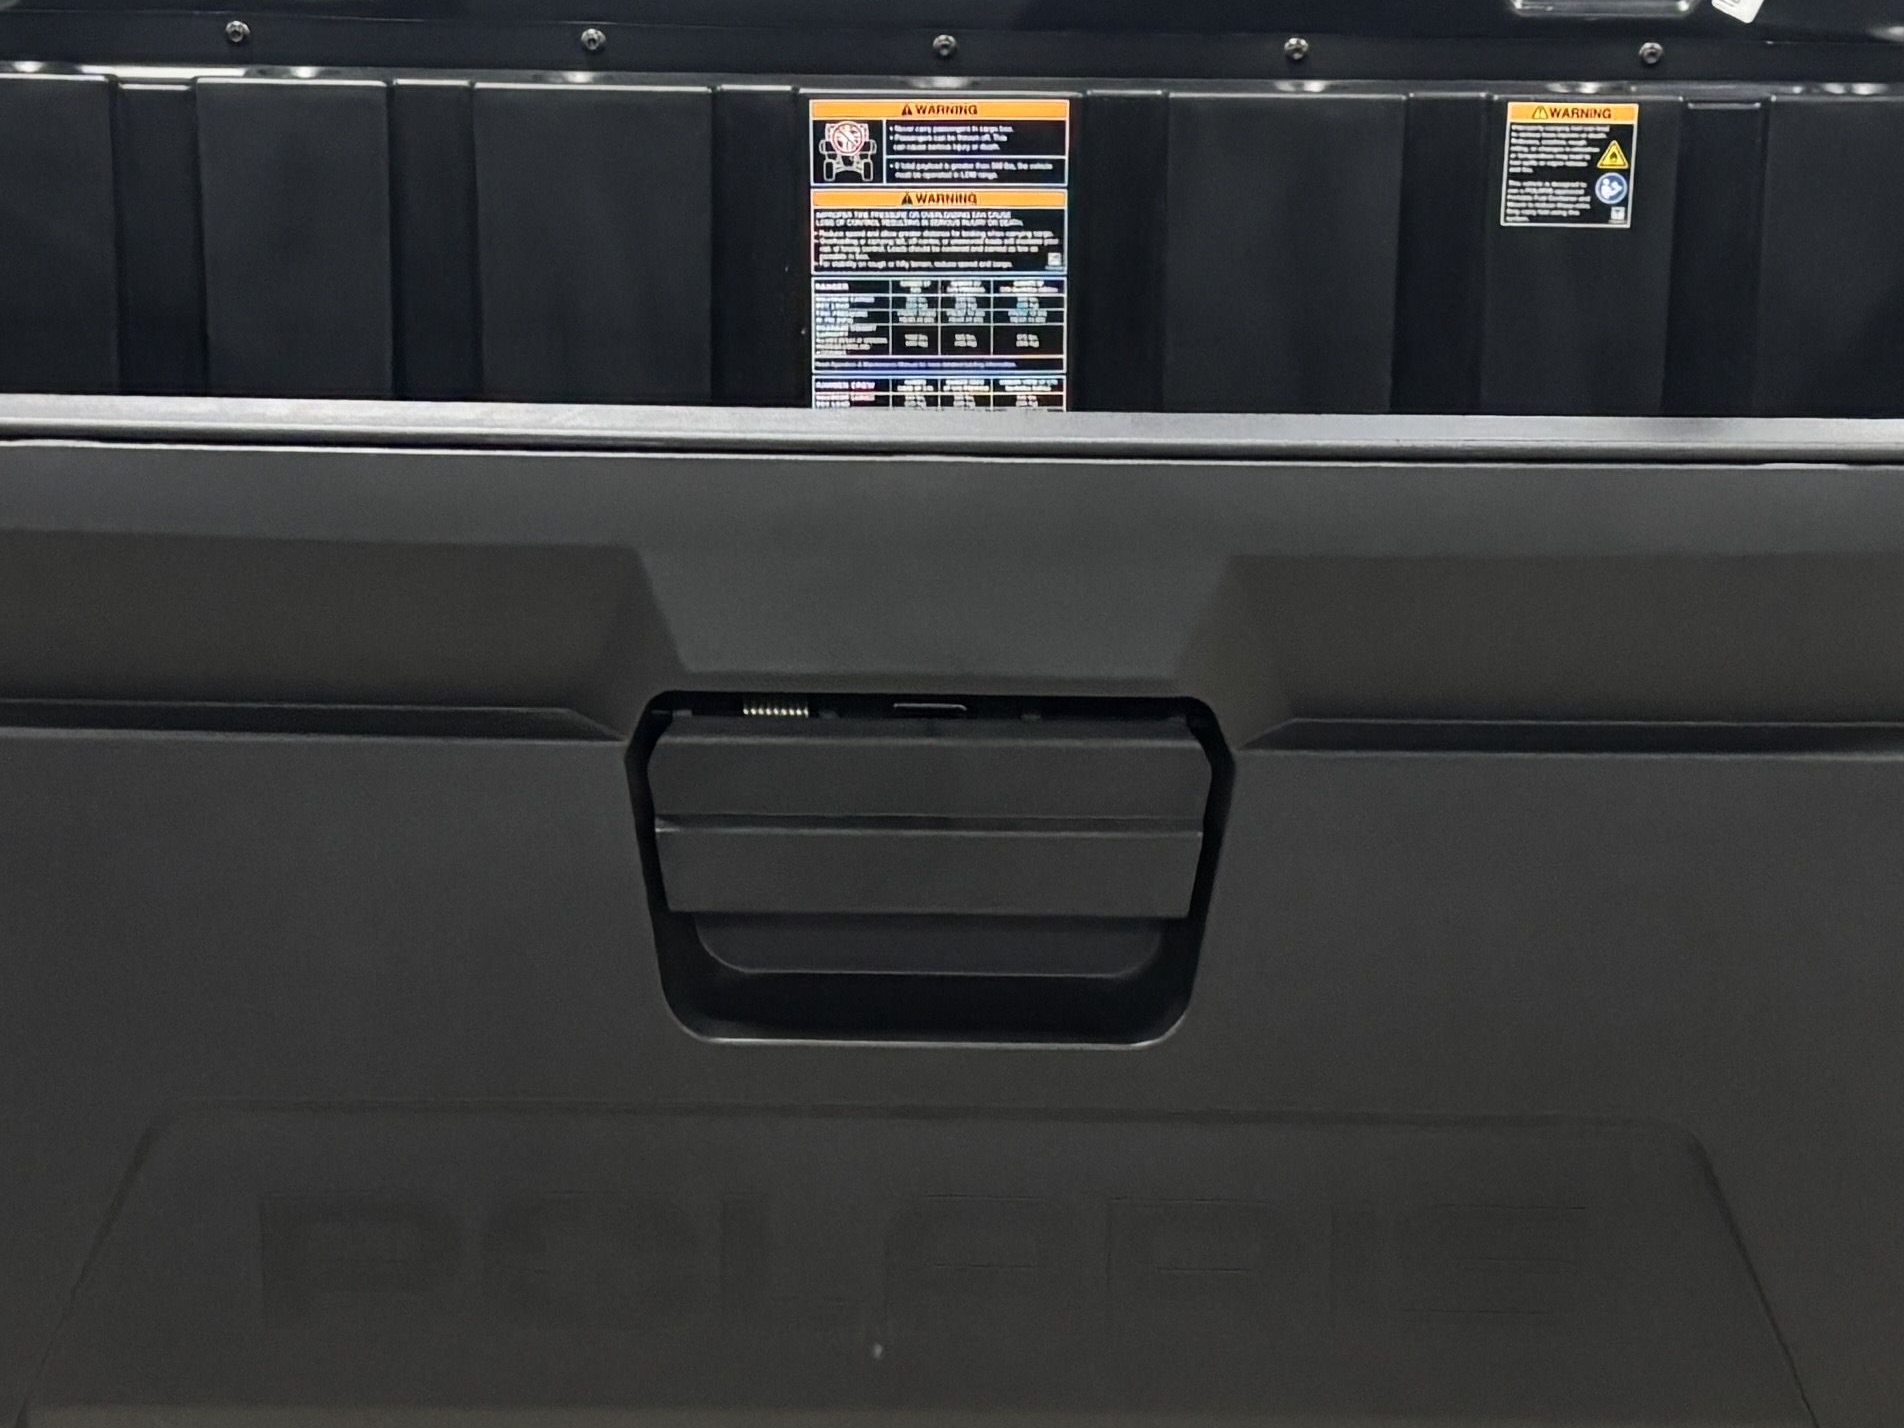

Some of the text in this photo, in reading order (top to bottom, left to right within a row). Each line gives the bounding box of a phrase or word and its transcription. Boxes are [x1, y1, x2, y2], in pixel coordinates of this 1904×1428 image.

[915, 104, 979, 116] WARNING
[1549, 107, 1612, 119] WARNING
[915, 193, 978, 205] WARNING
